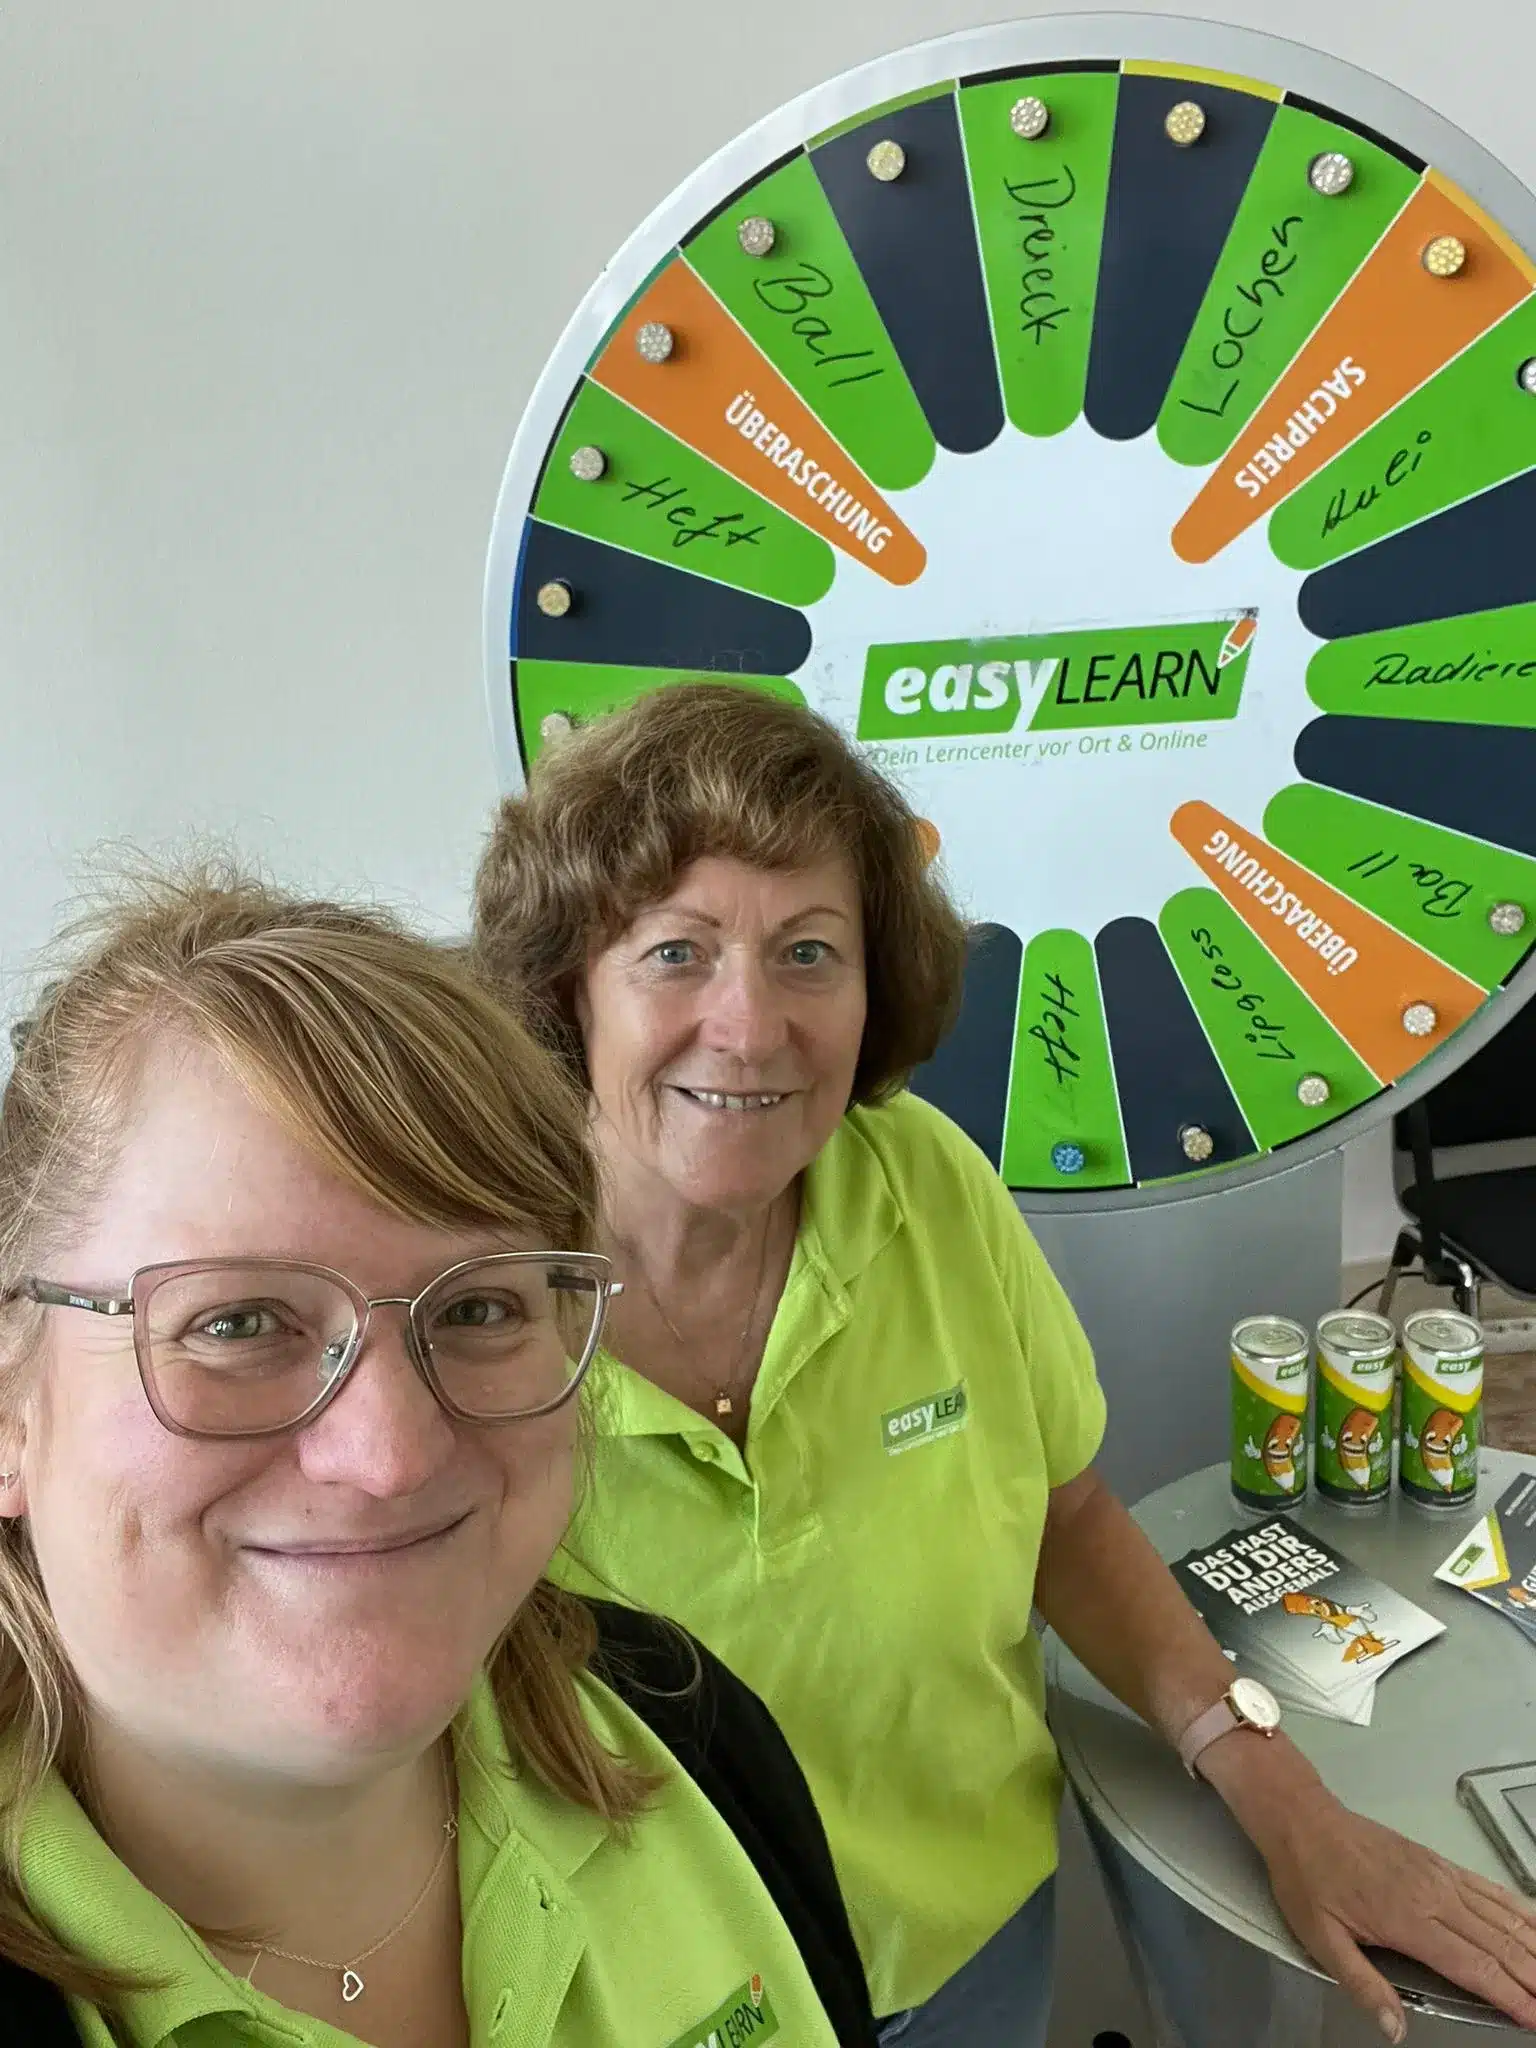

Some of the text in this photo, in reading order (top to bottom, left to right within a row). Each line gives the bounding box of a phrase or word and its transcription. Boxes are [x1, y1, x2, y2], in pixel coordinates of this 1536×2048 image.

[1004, 165, 1076, 346] Dreieck
[753, 263, 884, 388] Ball
[1234, 356, 1367, 499] SACHPREIS
[724, 389, 894, 554] ÜBERASCHUNG
[621, 477, 767, 548] Heft
[884, 648, 1222, 733] easyLEARN
[872, 730, 1208, 766] Dein Lerncenter vor Ort & Online
[1202, 829, 1360, 977] ÜBERASCHUNG
[1347, 850, 1473, 918] Ball
[1028, 972, 1081, 1084] Heft
[1187, 1522, 1288, 1577] DAS HAST
[1201, 1535, 1311, 1592] DU DIR
[1226, 1548, 1328, 1606] ANDERS
[1241, 1560, 1341, 1616] AUSGEMALT
